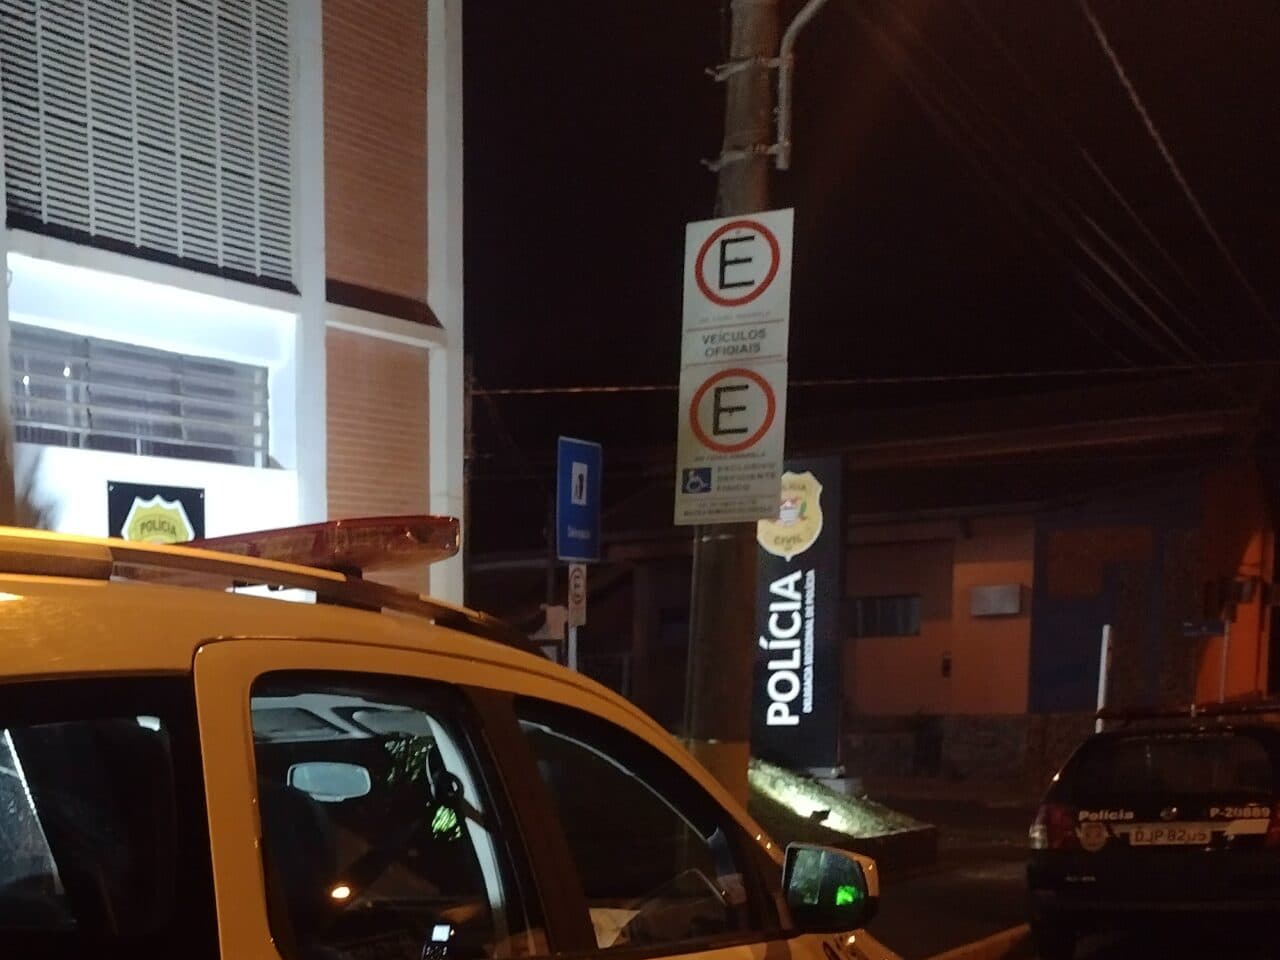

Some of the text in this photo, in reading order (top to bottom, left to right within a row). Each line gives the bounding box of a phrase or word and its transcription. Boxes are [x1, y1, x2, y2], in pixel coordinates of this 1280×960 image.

[720, 235, 755, 289] E
[713, 384, 750, 436] E
[759, 569, 802, 725] POLÍCIA
